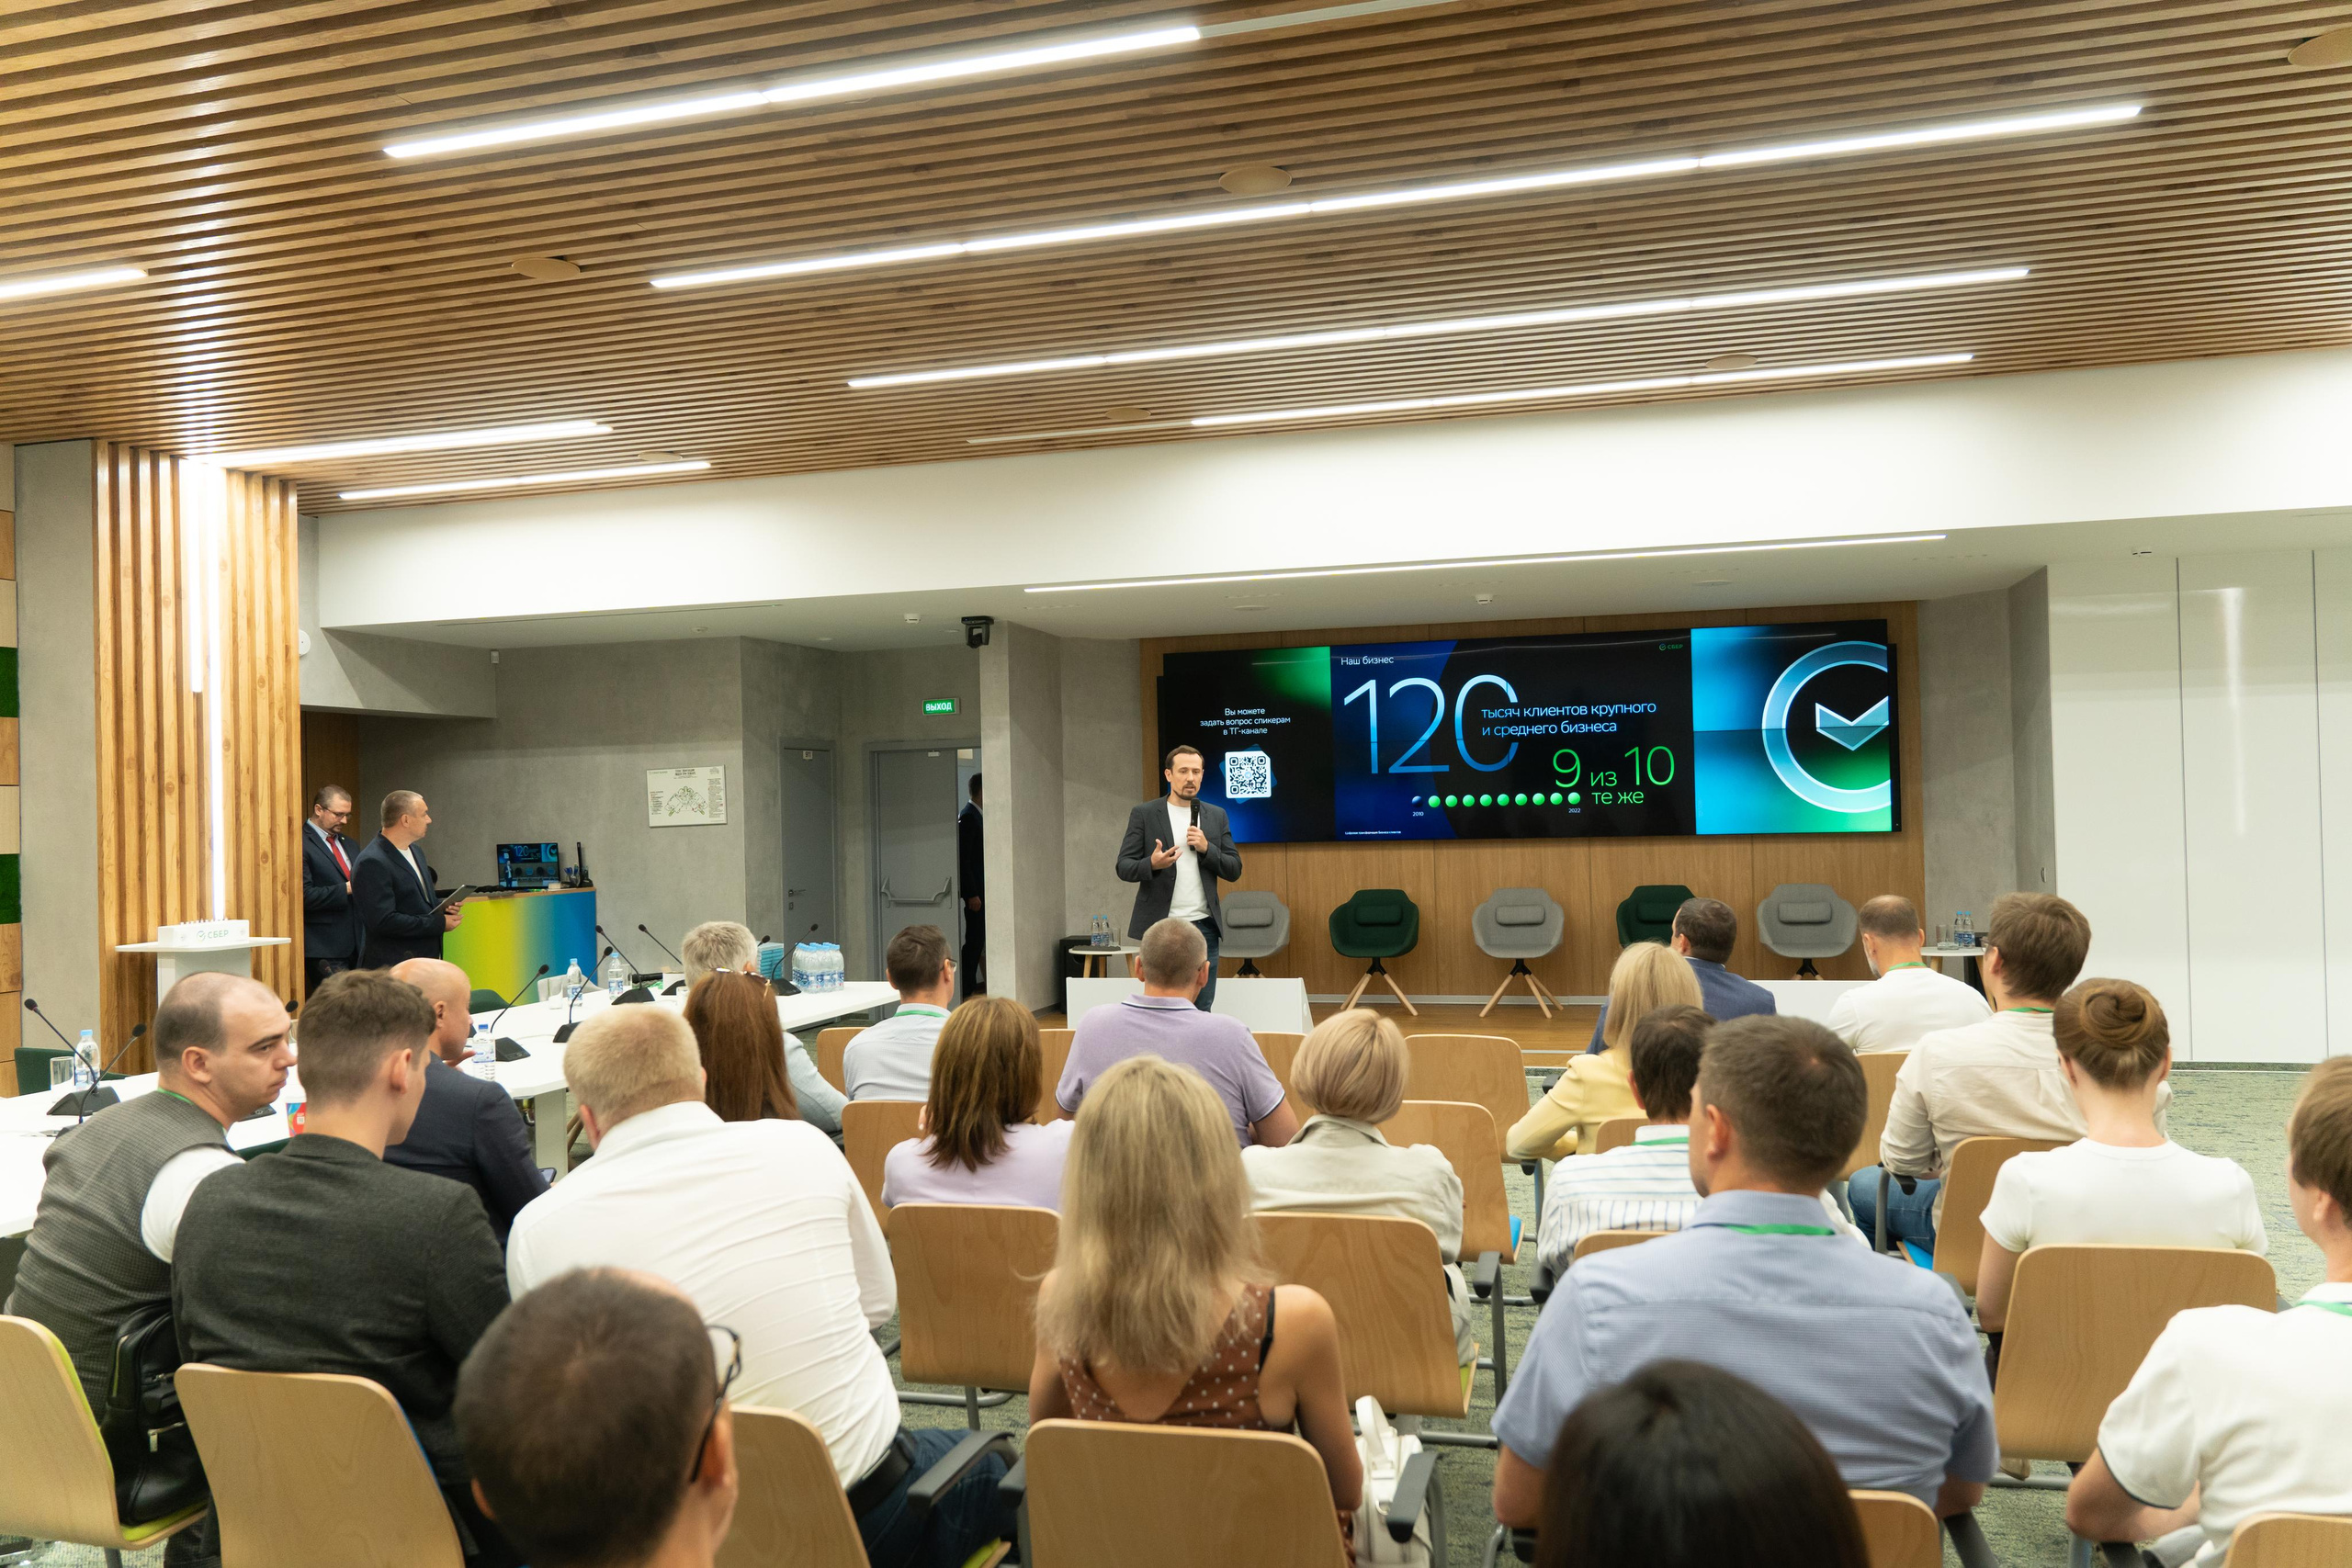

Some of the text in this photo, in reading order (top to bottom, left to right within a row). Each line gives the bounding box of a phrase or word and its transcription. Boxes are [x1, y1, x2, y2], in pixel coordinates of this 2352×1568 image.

[1340, 655, 1394, 666] Наш бизнес
[925, 702, 953, 711] ВЫХОД
[1225, 707, 1266, 716] Вы можете
[1481, 703, 1657, 719] тысяч клиентов крупного
[1226, 718, 1253, 727] вопрос
[1254, 716, 1291, 725] спикерам
[1343, 674, 1519, 774] 120
[1229, 727, 1268, 735] ТГ-канале
[1482, 720, 1617, 738] и среднего бизнеса
[1552, 745, 1675, 787] 9 из 10
[1591, 790, 1645, 805] те же
[208, 930, 229, 939] СБЕР
